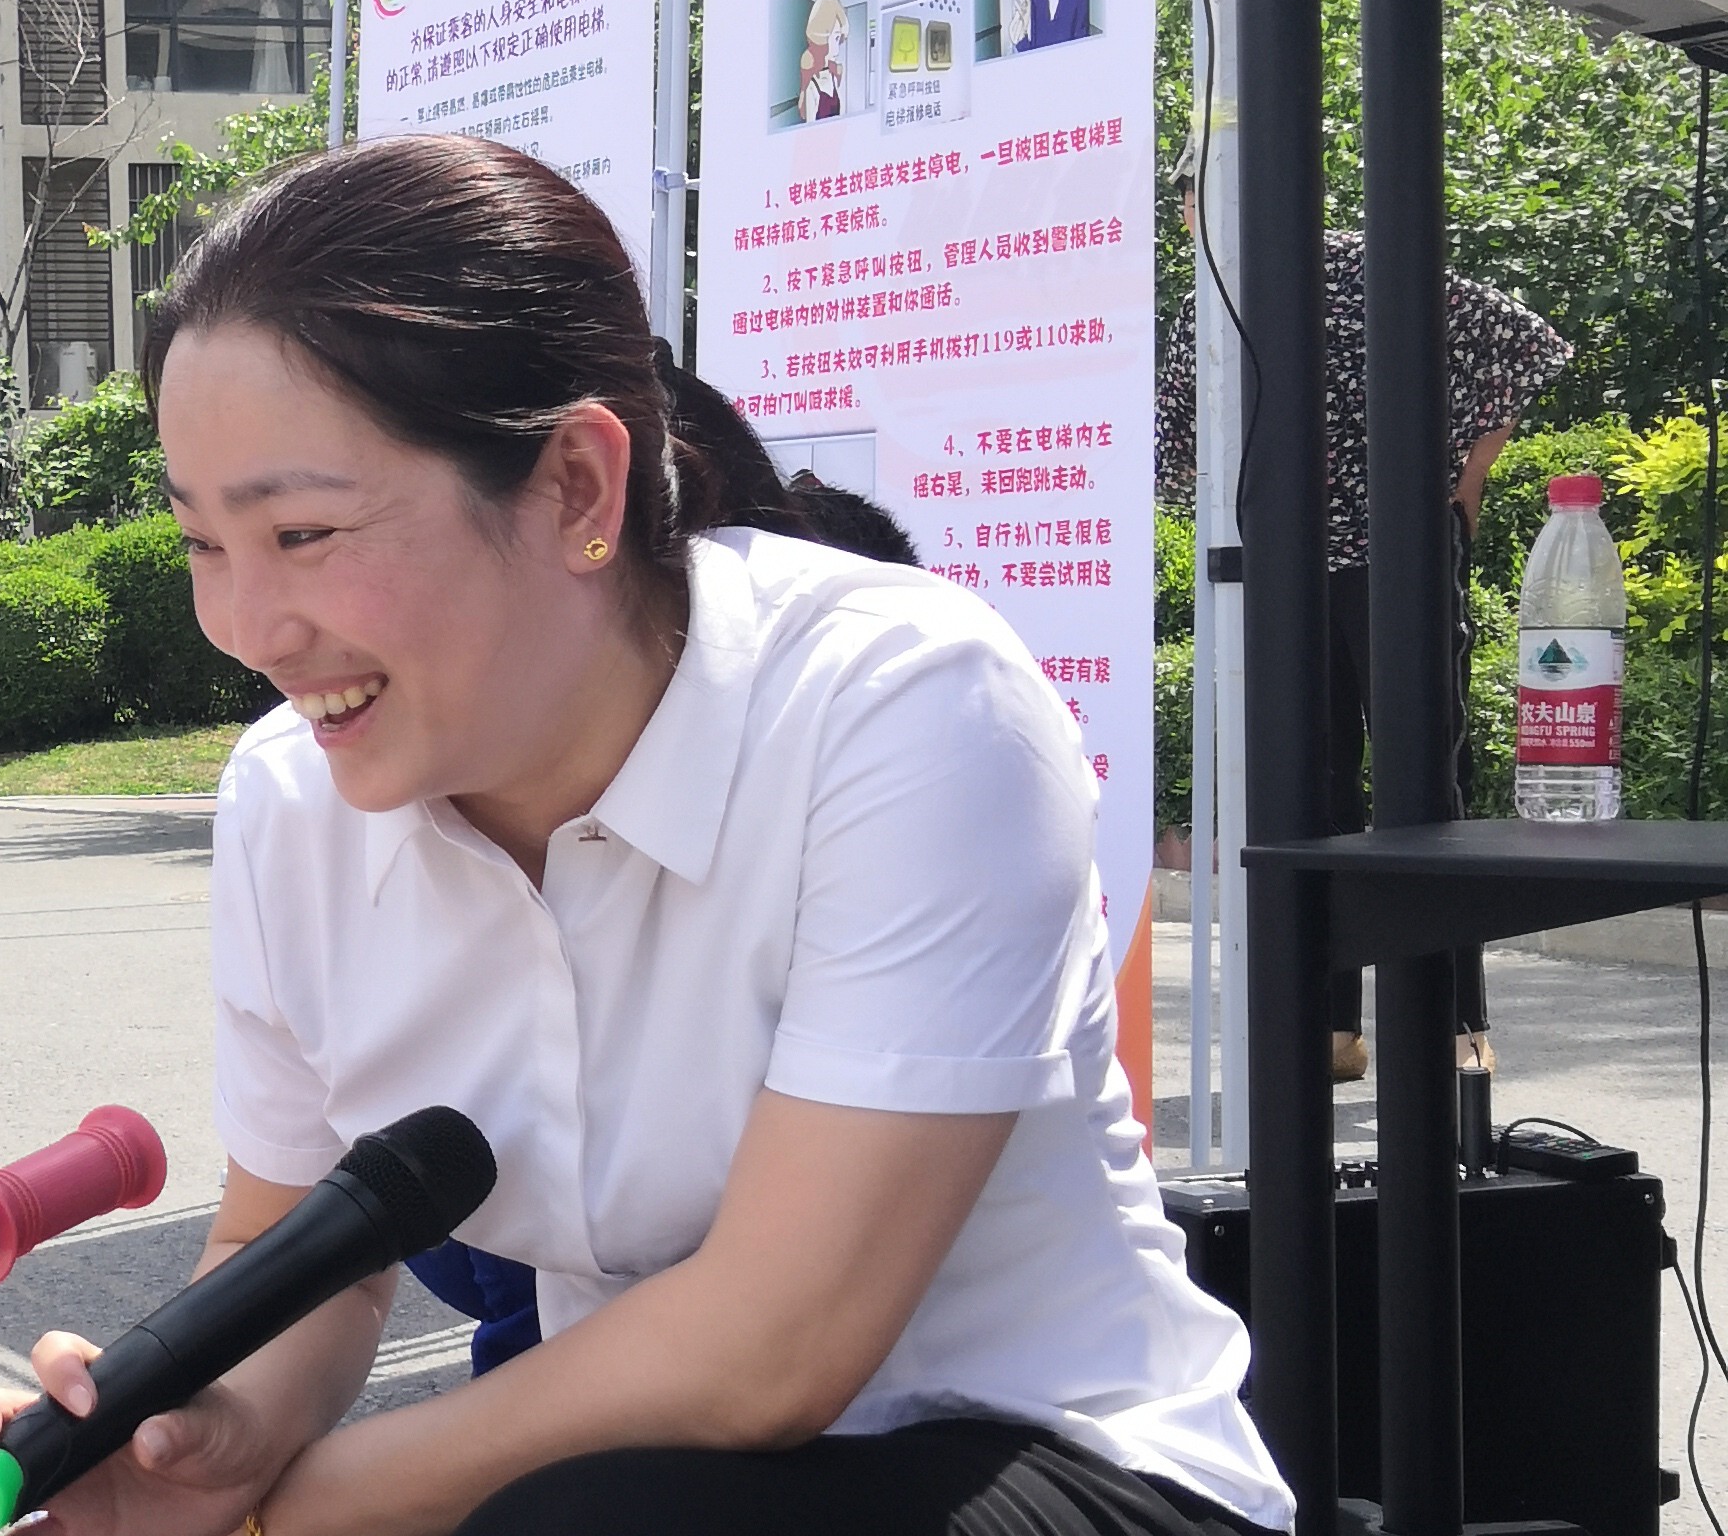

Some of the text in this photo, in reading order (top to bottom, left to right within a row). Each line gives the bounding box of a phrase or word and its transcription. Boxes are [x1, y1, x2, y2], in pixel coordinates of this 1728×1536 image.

[888, 79, 941, 100] 紧急呼叫按钮
[886, 101, 942, 127] 电梯报修电话
[734, 205, 888, 252] 请保持镇定,不要惊慌。
[732, 282, 961, 336] 通过电梯内的对讲装置和你通话。
[944, 420, 1114, 458] 4、不要在电梯内左
[913, 465, 1095, 499] 摇右晃,来回跑跳走动。
[943, 517, 1112, 549] 5、自行扒门是很危
[1034, 655, 1110, 684] 板若有紧
[1521, 701, 1596, 724] 农夫山泉
[1555, 725, 1596, 737] SPRING
